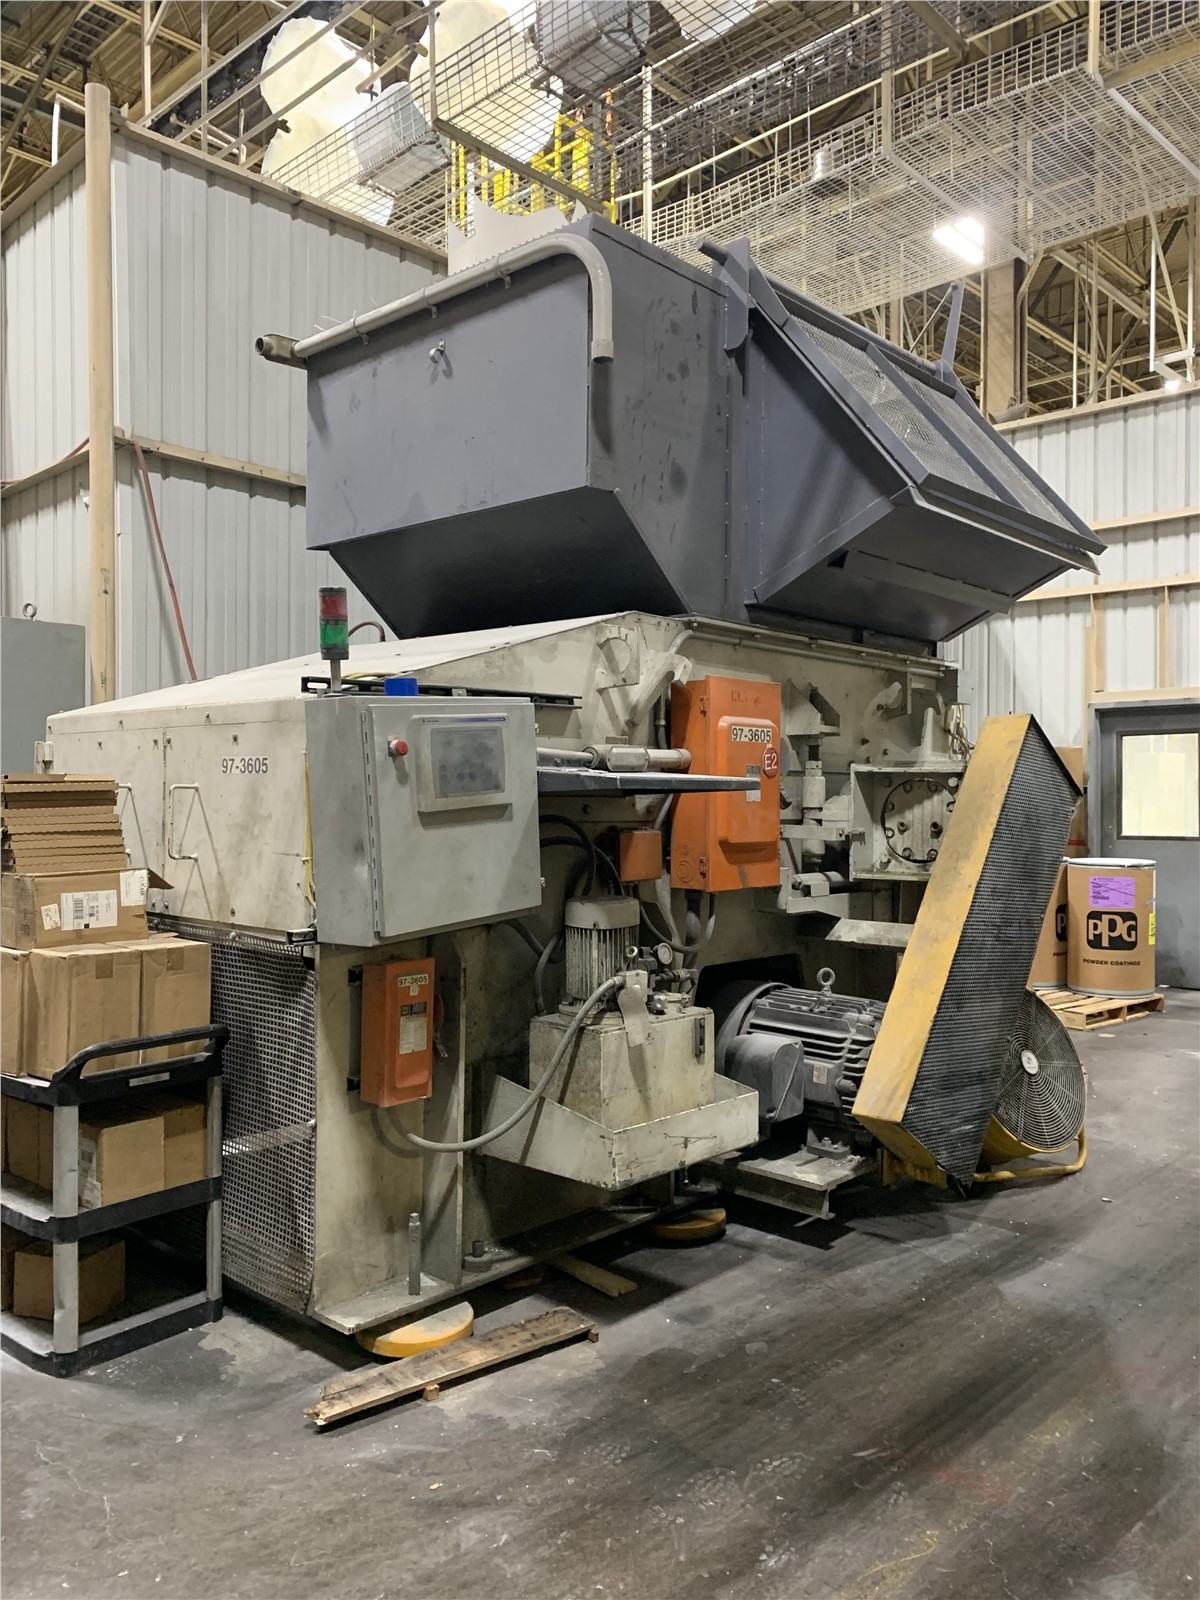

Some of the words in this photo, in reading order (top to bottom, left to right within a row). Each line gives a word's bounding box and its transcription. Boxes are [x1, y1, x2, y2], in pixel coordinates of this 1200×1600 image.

[732, 727, 771, 742] 97-3605
[222, 757, 268, 774] 97-3605
[764, 753, 777, 770] E2
[1088, 914, 1136, 947] PPG
[1083, 958, 1108, 966] POWDER
[398, 976, 428, 986] 97-3605
